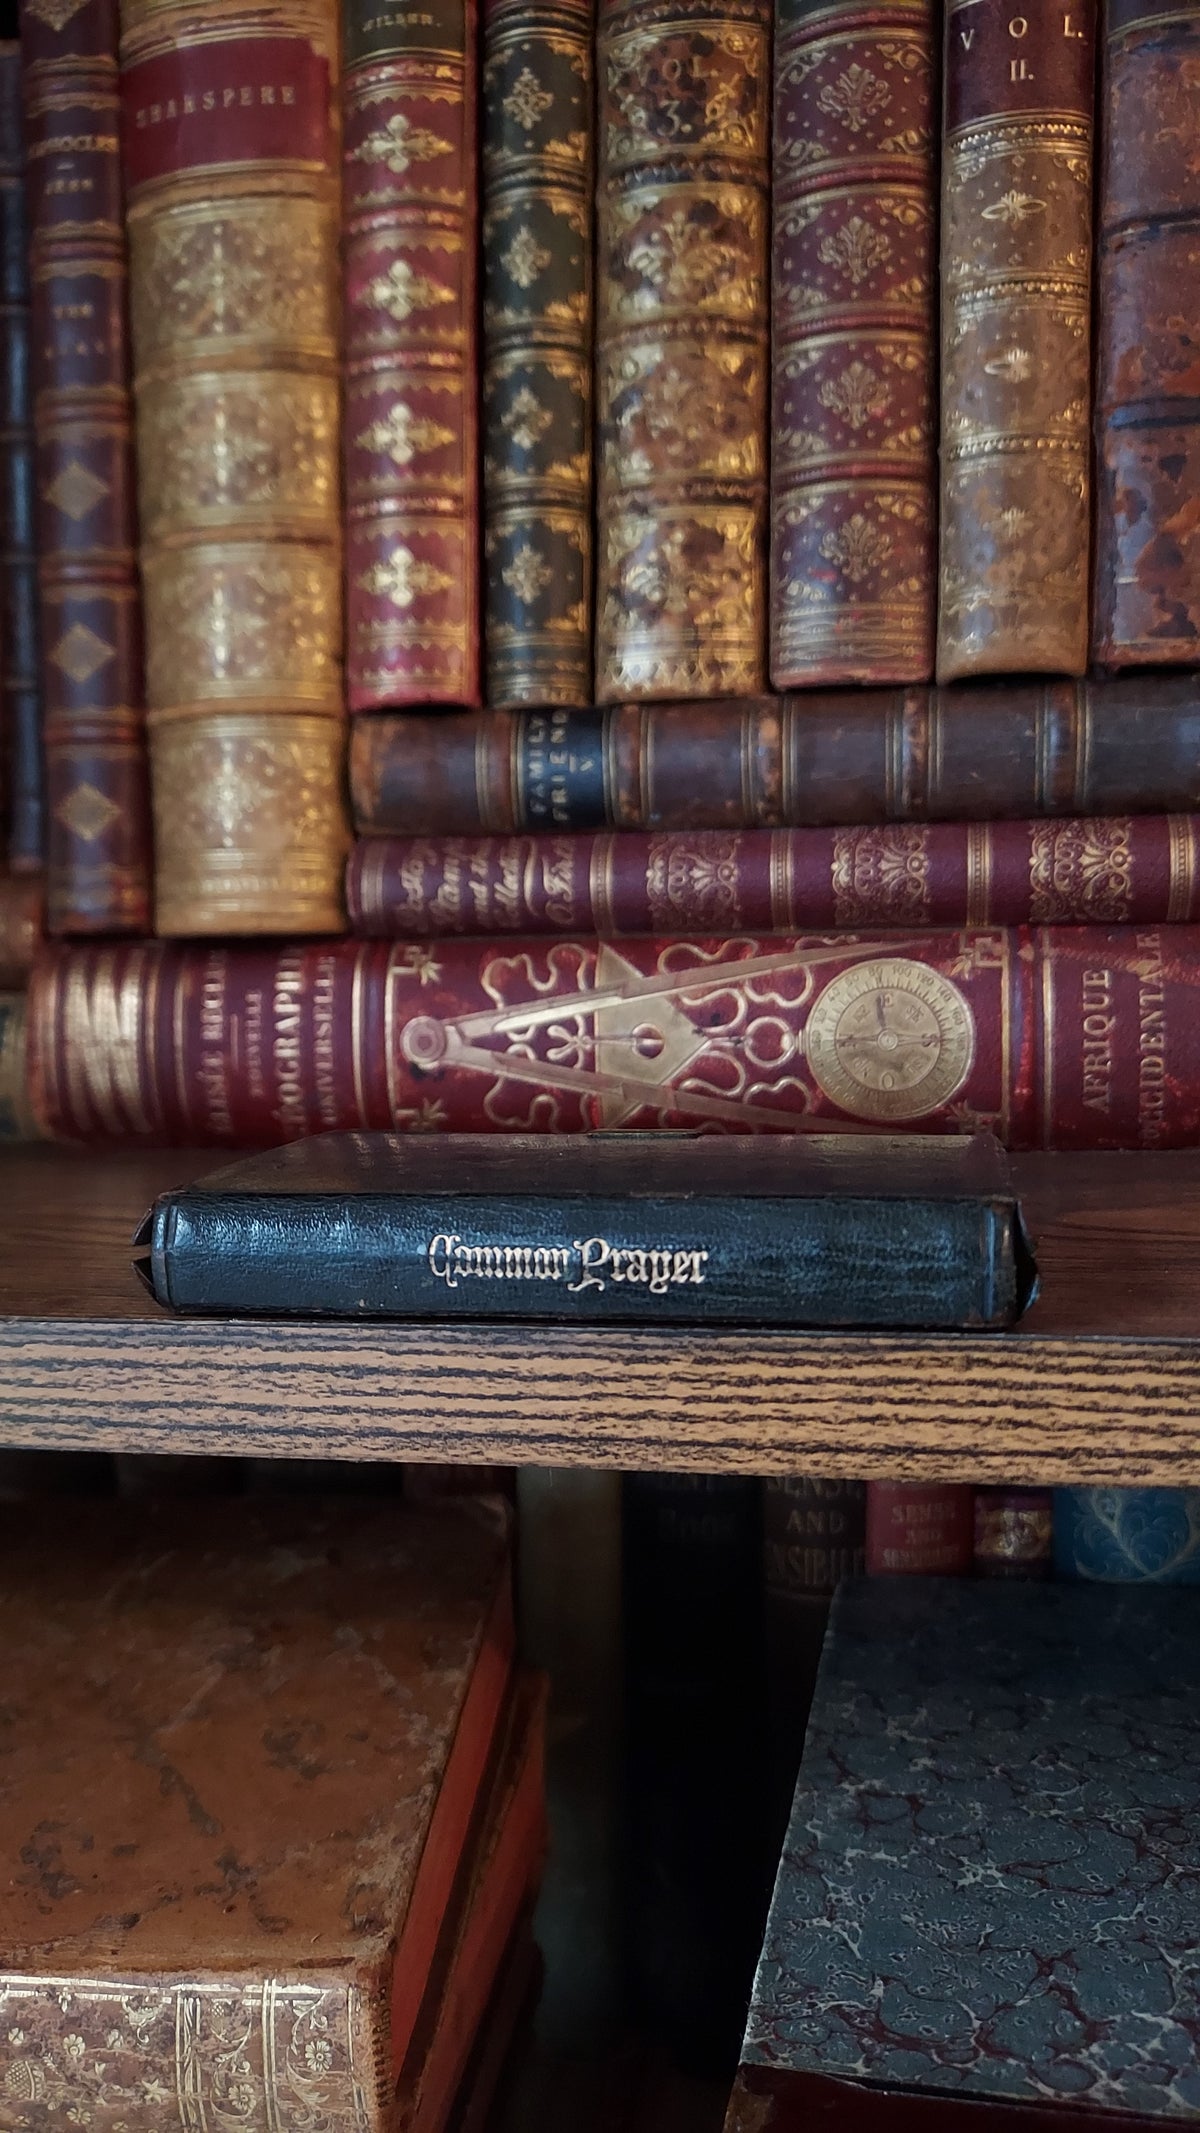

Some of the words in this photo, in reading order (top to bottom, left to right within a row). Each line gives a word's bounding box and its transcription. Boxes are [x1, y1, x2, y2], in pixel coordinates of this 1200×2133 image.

[1010, 59, 1034, 81] II.
[529, 716, 546, 813] FAMILY
[550, 711, 568, 821] FRIEND
[1082, 969, 1116, 1115] AFRIQUE
[429, 1234, 571, 1287] Common
[567, 1237, 709, 1293] Prayer
[786, 1509, 846, 1535] AND
